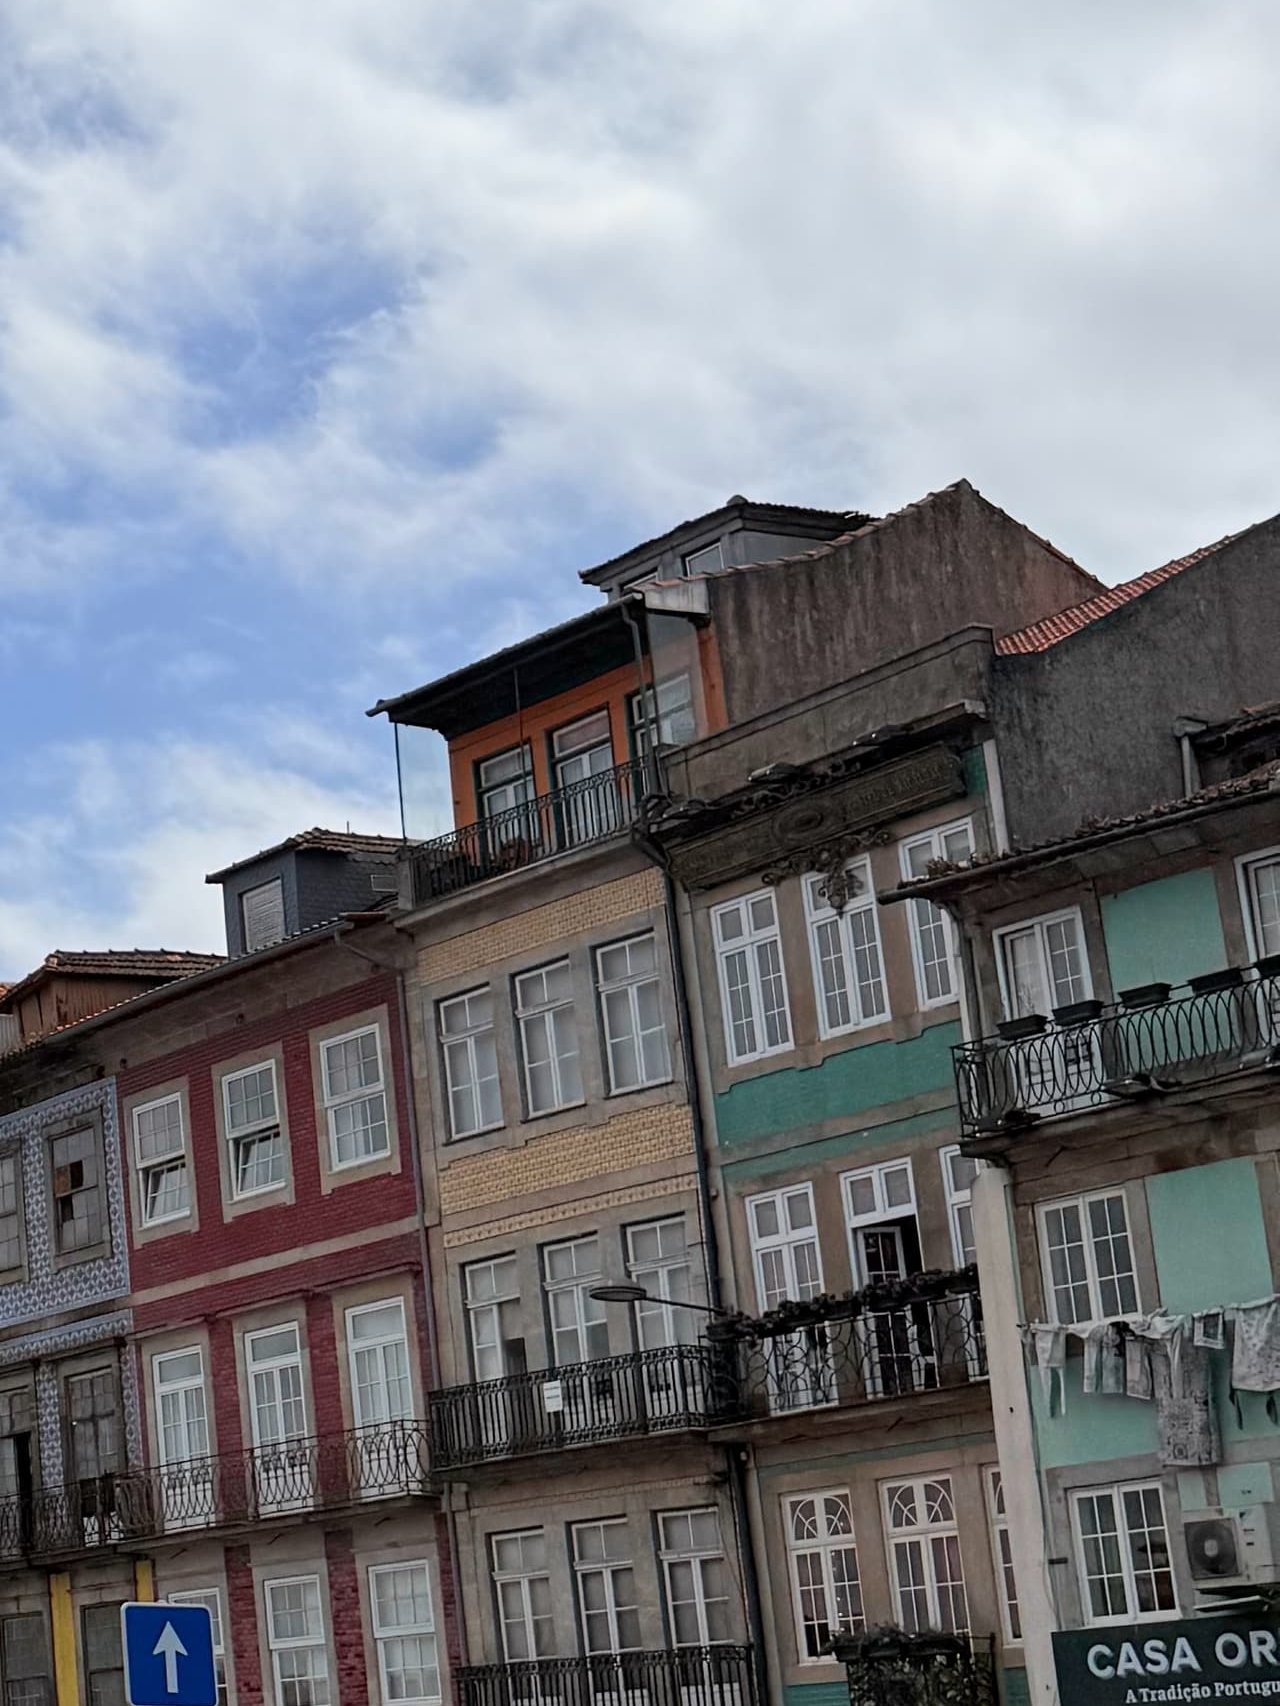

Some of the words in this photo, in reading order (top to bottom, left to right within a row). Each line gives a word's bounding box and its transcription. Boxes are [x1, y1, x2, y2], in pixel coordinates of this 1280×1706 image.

[1087, 1637, 1202, 1680] CASA
[1215, 1629, 1280, 1668] OR
[1125, 1689, 1138, 1704] A
[1138, 1683, 1211, 1702] Tradição
